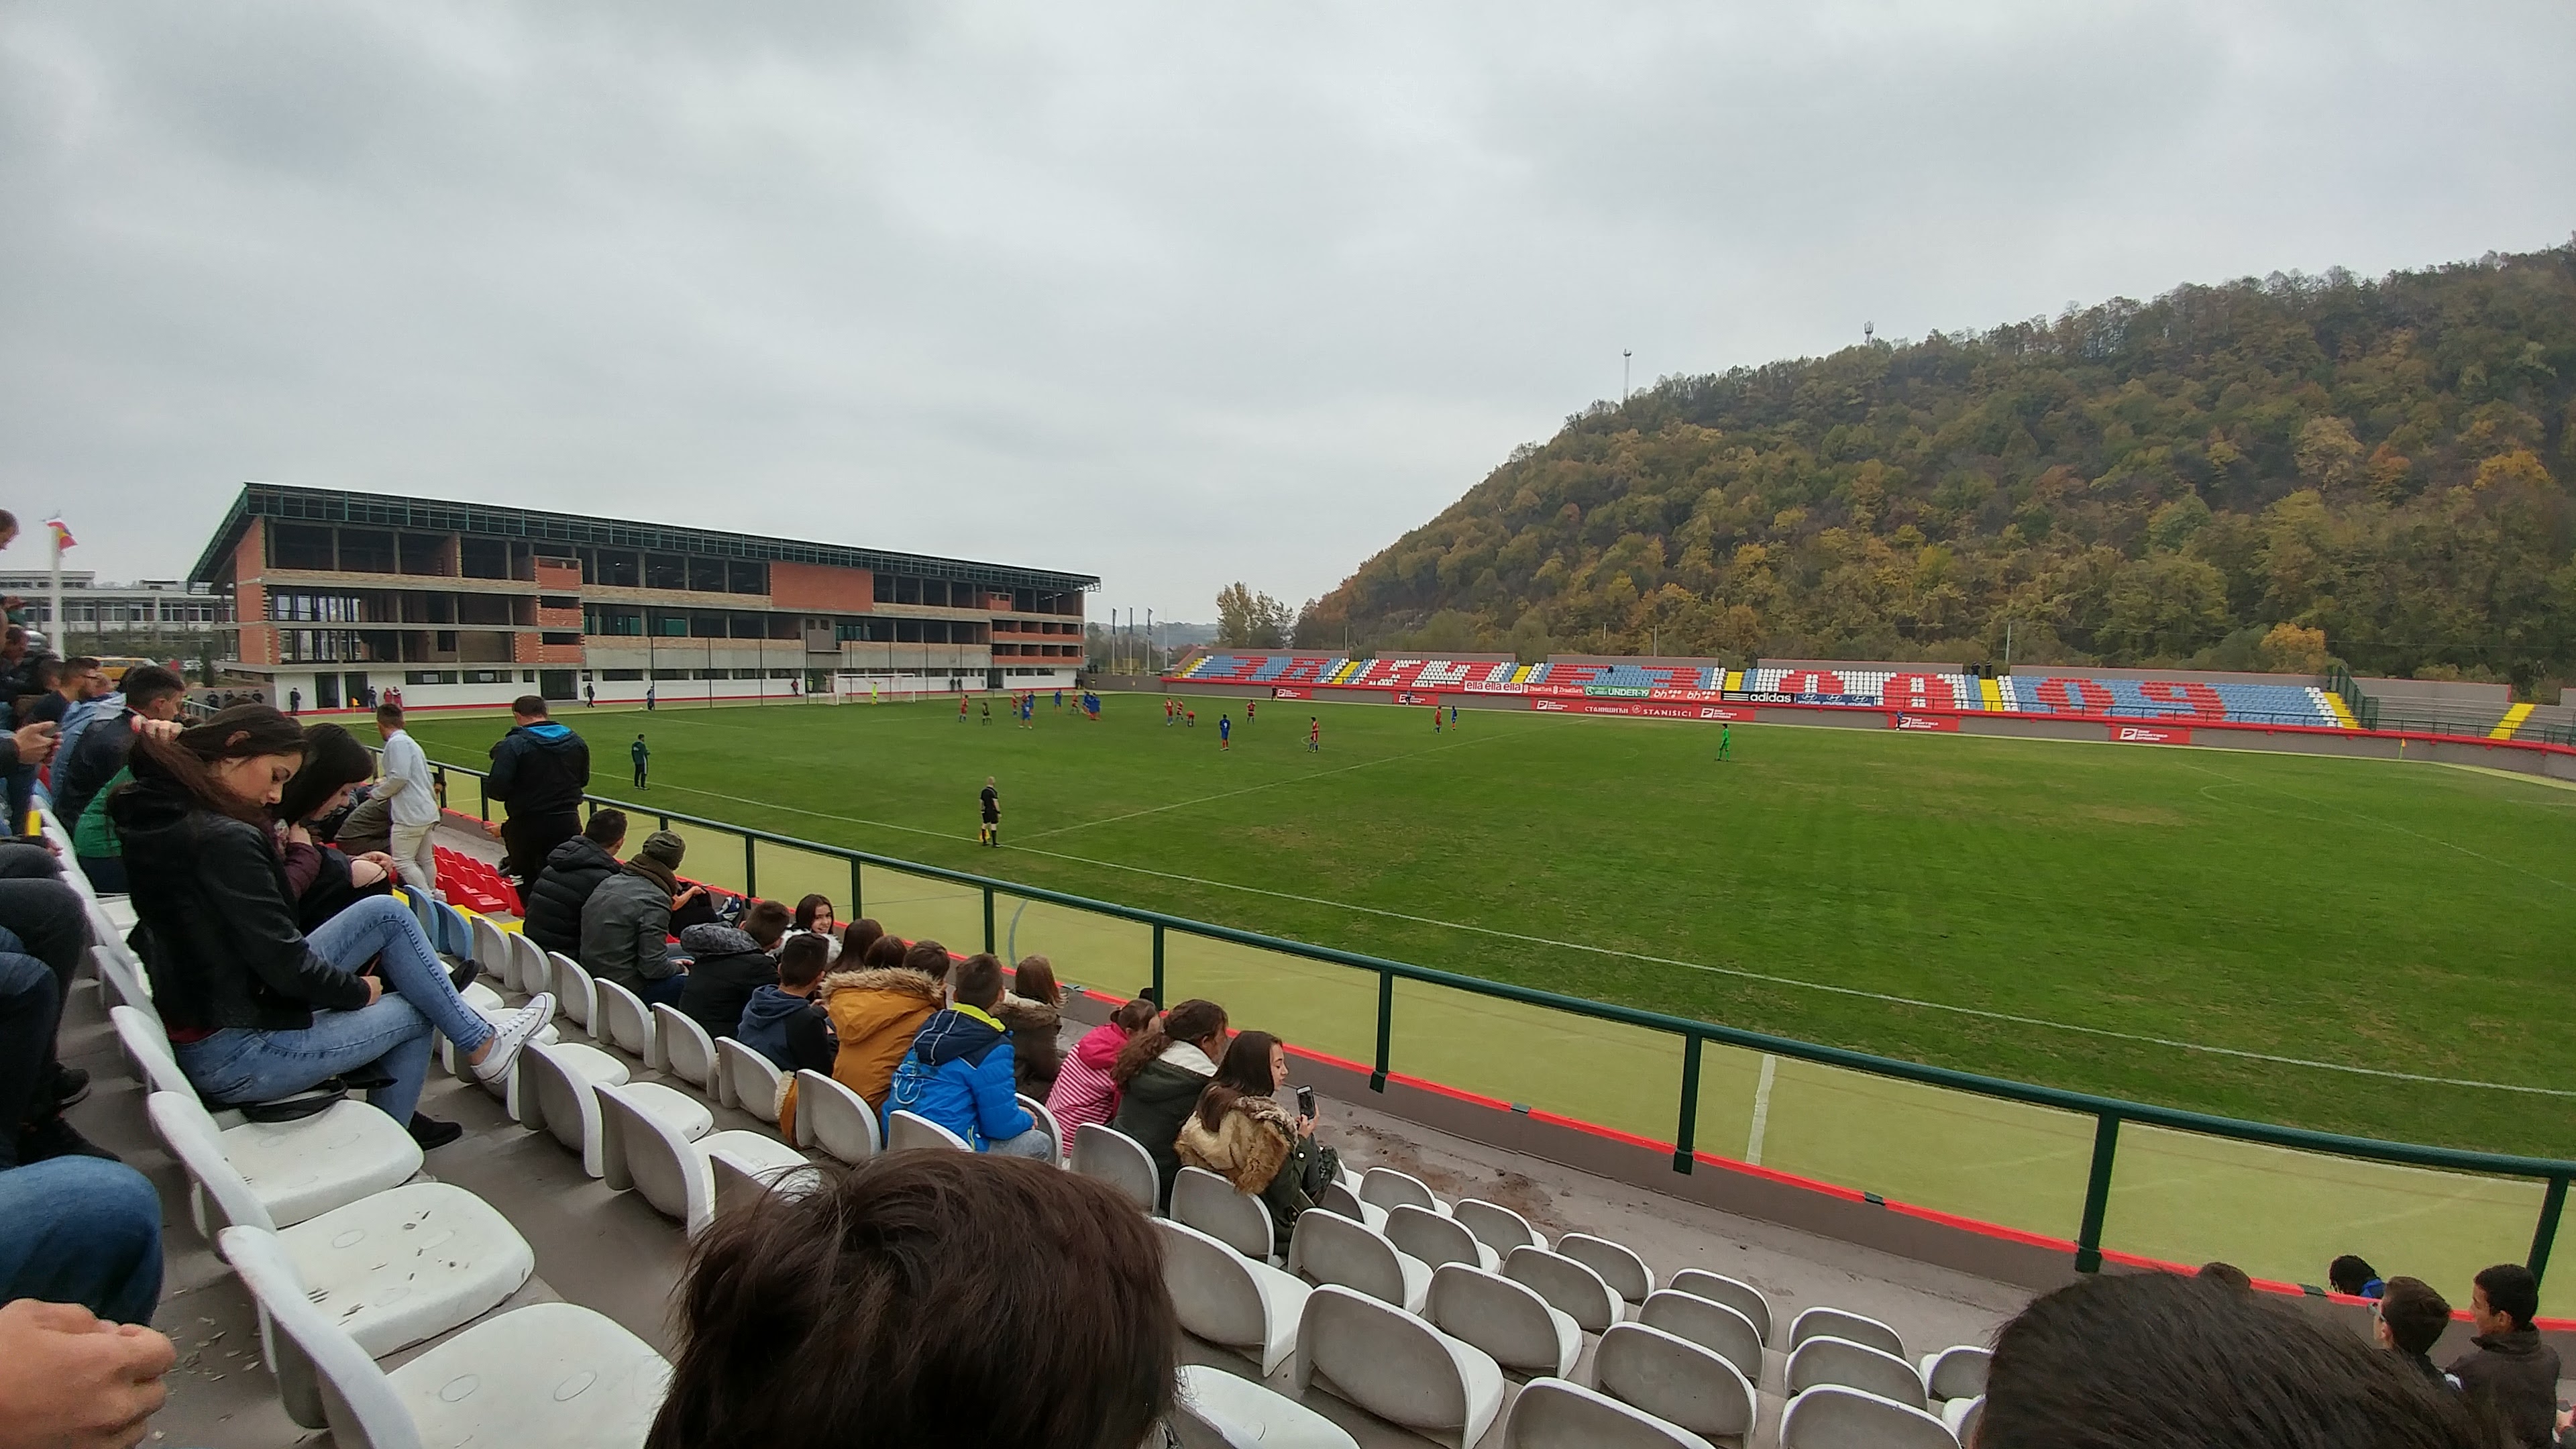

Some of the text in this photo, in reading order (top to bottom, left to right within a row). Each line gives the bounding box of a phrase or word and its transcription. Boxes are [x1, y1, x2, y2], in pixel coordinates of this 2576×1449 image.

[1466, 682, 1521, 691] ella ella ella
[1608, 688, 1649, 696] UNDER-19
[1750, 693, 1791, 703] adidas
